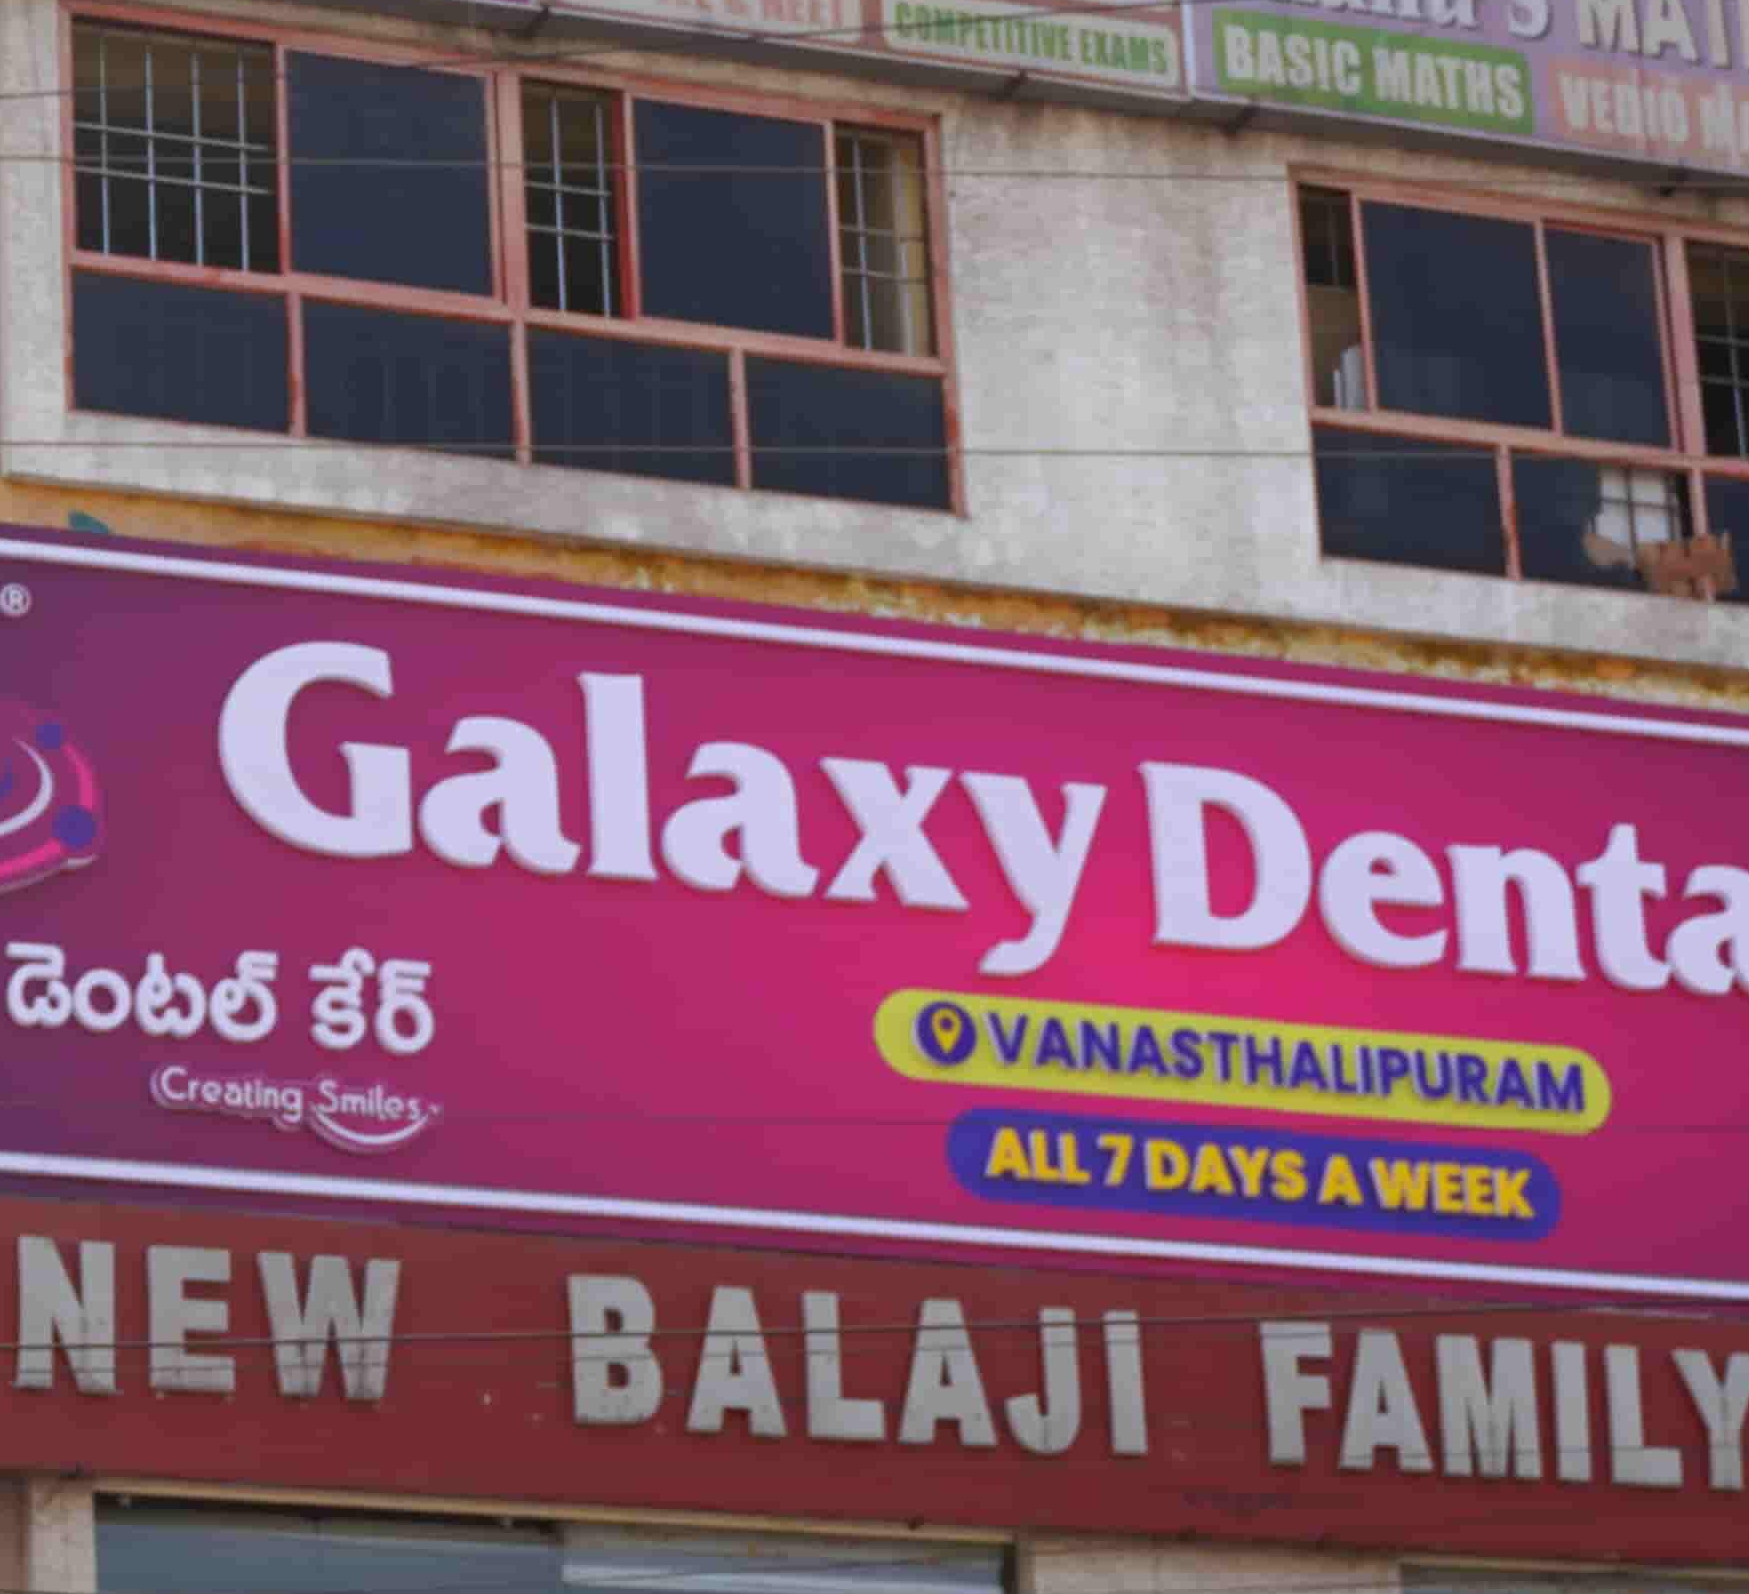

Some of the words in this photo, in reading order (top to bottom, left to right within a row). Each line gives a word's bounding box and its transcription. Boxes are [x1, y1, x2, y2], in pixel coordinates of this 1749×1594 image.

[893, 0, 1073, 62] COMPETITIVE
[1081, 27, 1169, 76] EXAMS
[1221, 22, 1362, 95] BASIC
[1374, 46, 1526, 122] MATHS
[217, 639, 1108, 977] Galaxy
[4, 939, 281, 1045] డెంటల్
[308, 947, 436, 1056] కేర్
[158, 1063, 303, 1130] Creating
[317, 1079, 424, 1123] Smiles
[985, 1011, 1588, 1114] VANASTHALIPURAM
[985, 1125, 1090, 1187] ALL
[1101, 1134, 1135, 1189] 7
[1143, 1138, 1307, 1204] DAYS
[1318, 1153, 1363, 1206] A
[1369, 1159, 1535, 1220] WEEK
[13, 1234, 402, 1402] NEW
[565, 1272, 1149, 1456] BALAJI
